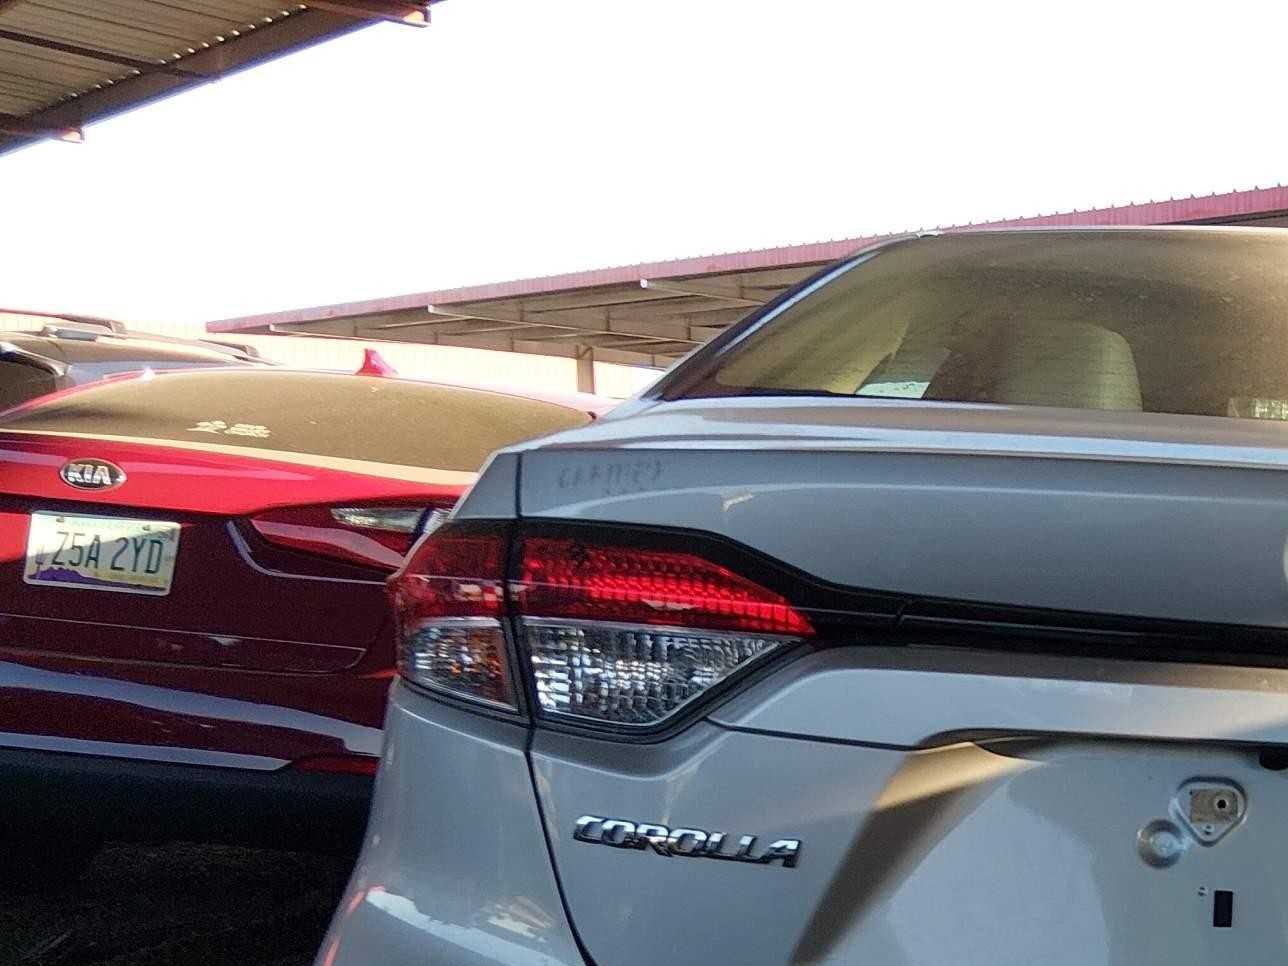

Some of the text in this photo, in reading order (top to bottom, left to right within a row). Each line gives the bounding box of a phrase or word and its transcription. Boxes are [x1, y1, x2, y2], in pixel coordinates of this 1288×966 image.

[66, 462, 113, 486] KIA
[51, 530, 164, 574] Z5A 2YD
[573, 815, 802, 868] COROLLA
